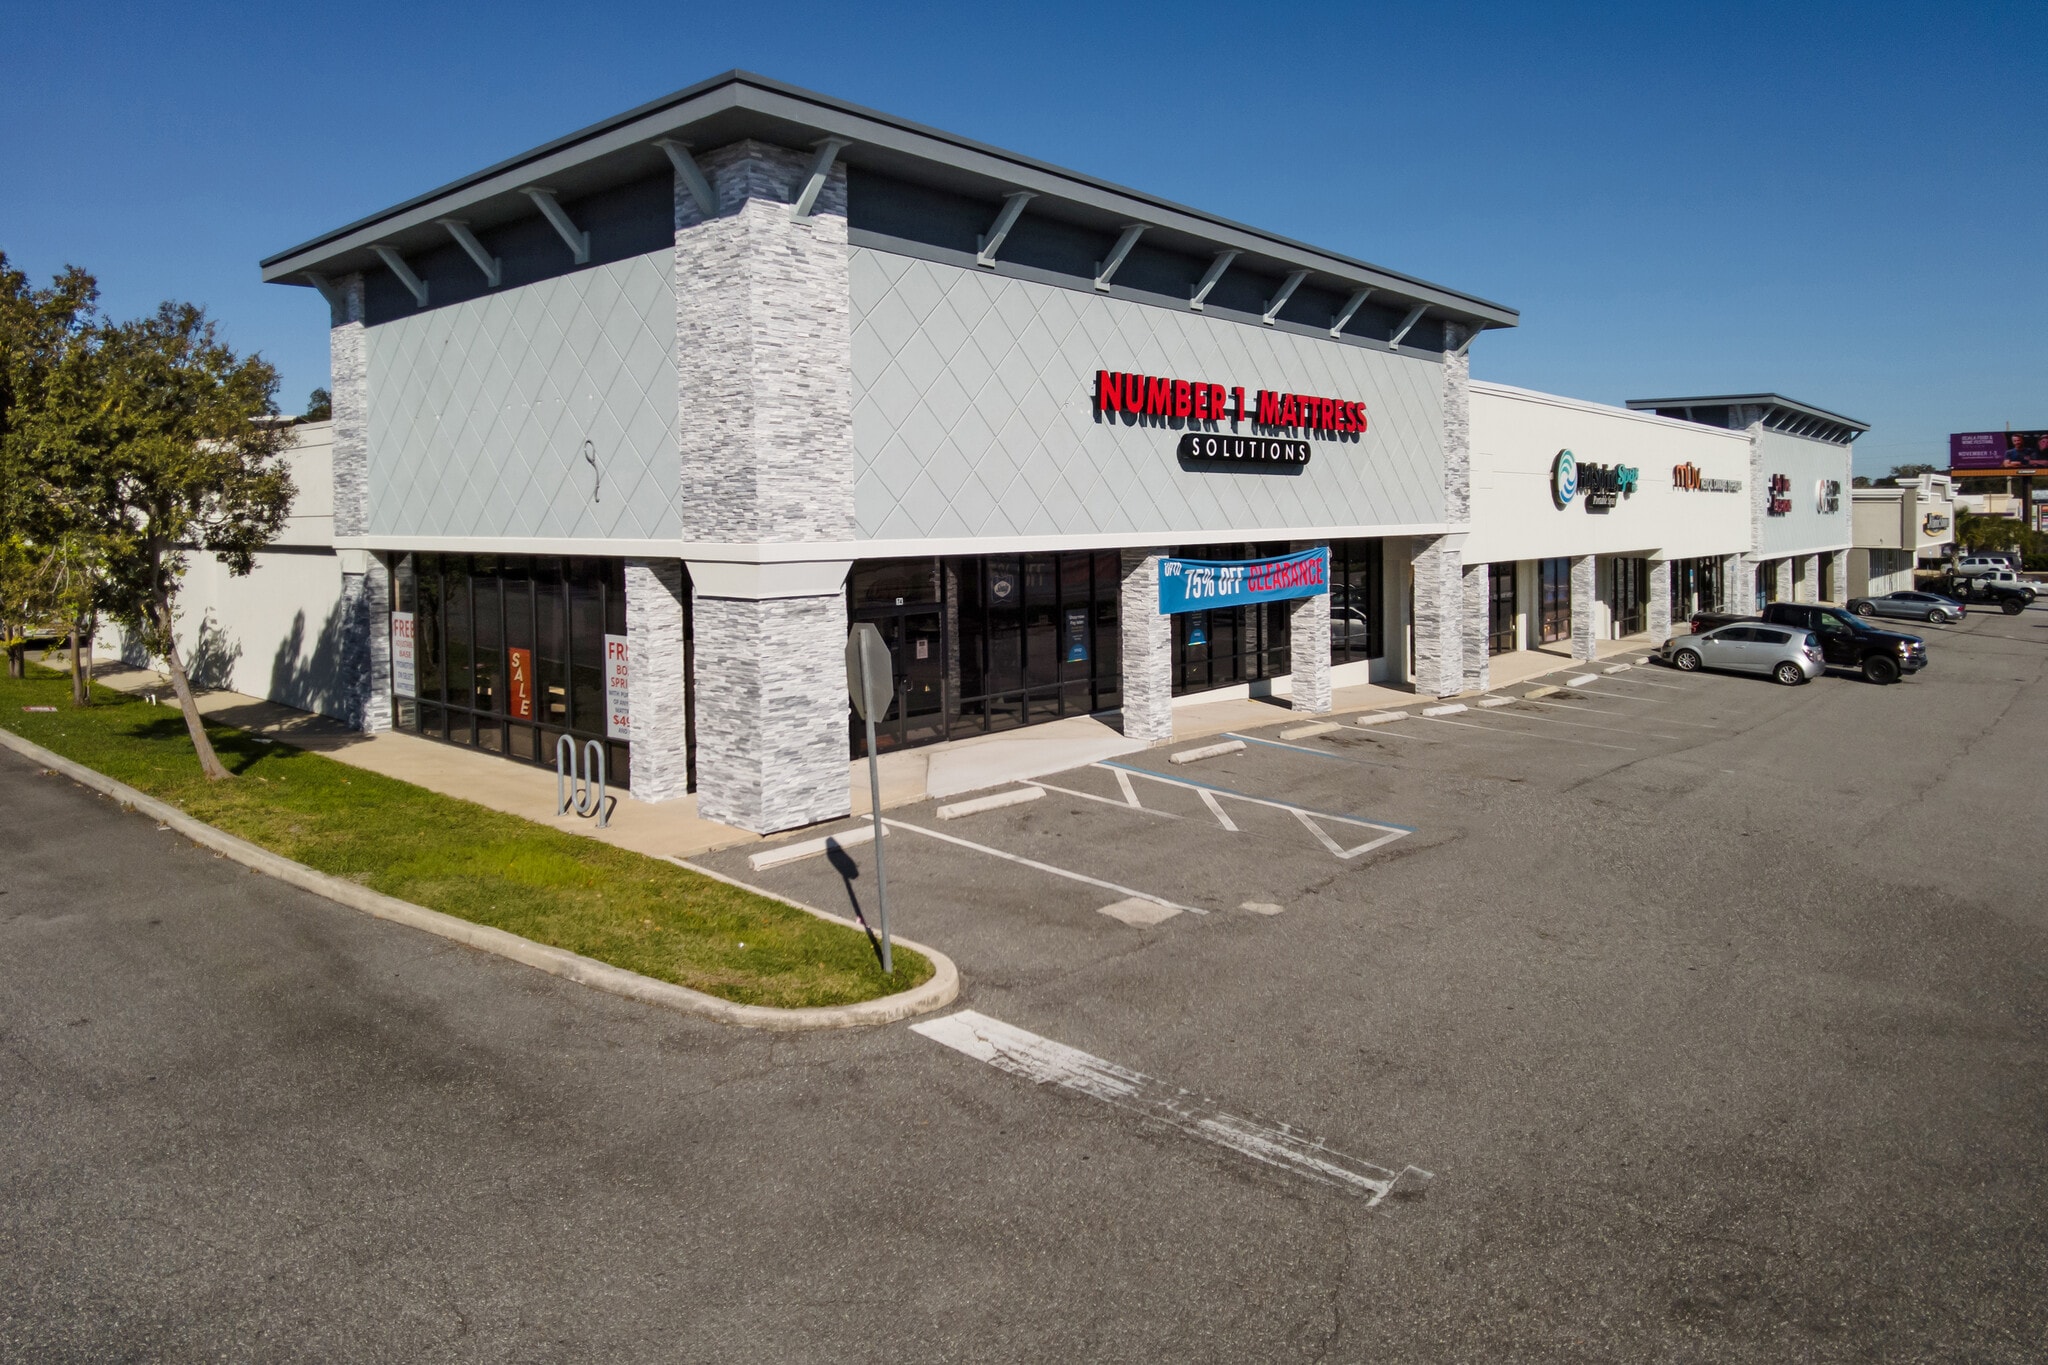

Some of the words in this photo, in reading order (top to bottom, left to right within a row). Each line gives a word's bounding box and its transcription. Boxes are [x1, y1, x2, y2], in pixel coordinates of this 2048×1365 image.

[1096, 369, 1226, 420] NUMBER
[1230, 386, 1246, 422] 1
[1256, 389, 1368, 433] MATTRESS
[1191, 437, 1306, 461] SOLUTIONS
[1184, 568, 1215, 600] 75%
[1218, 567, 1245, 596] OFF
[1247, 557, 1323, 593] CLEARANCE
[608, 642, 629, 661] FR
[611, 677, 628, 688] SPRI
[616, 665, 629, 676] BO
[511, 652, 531, 716] SALE
